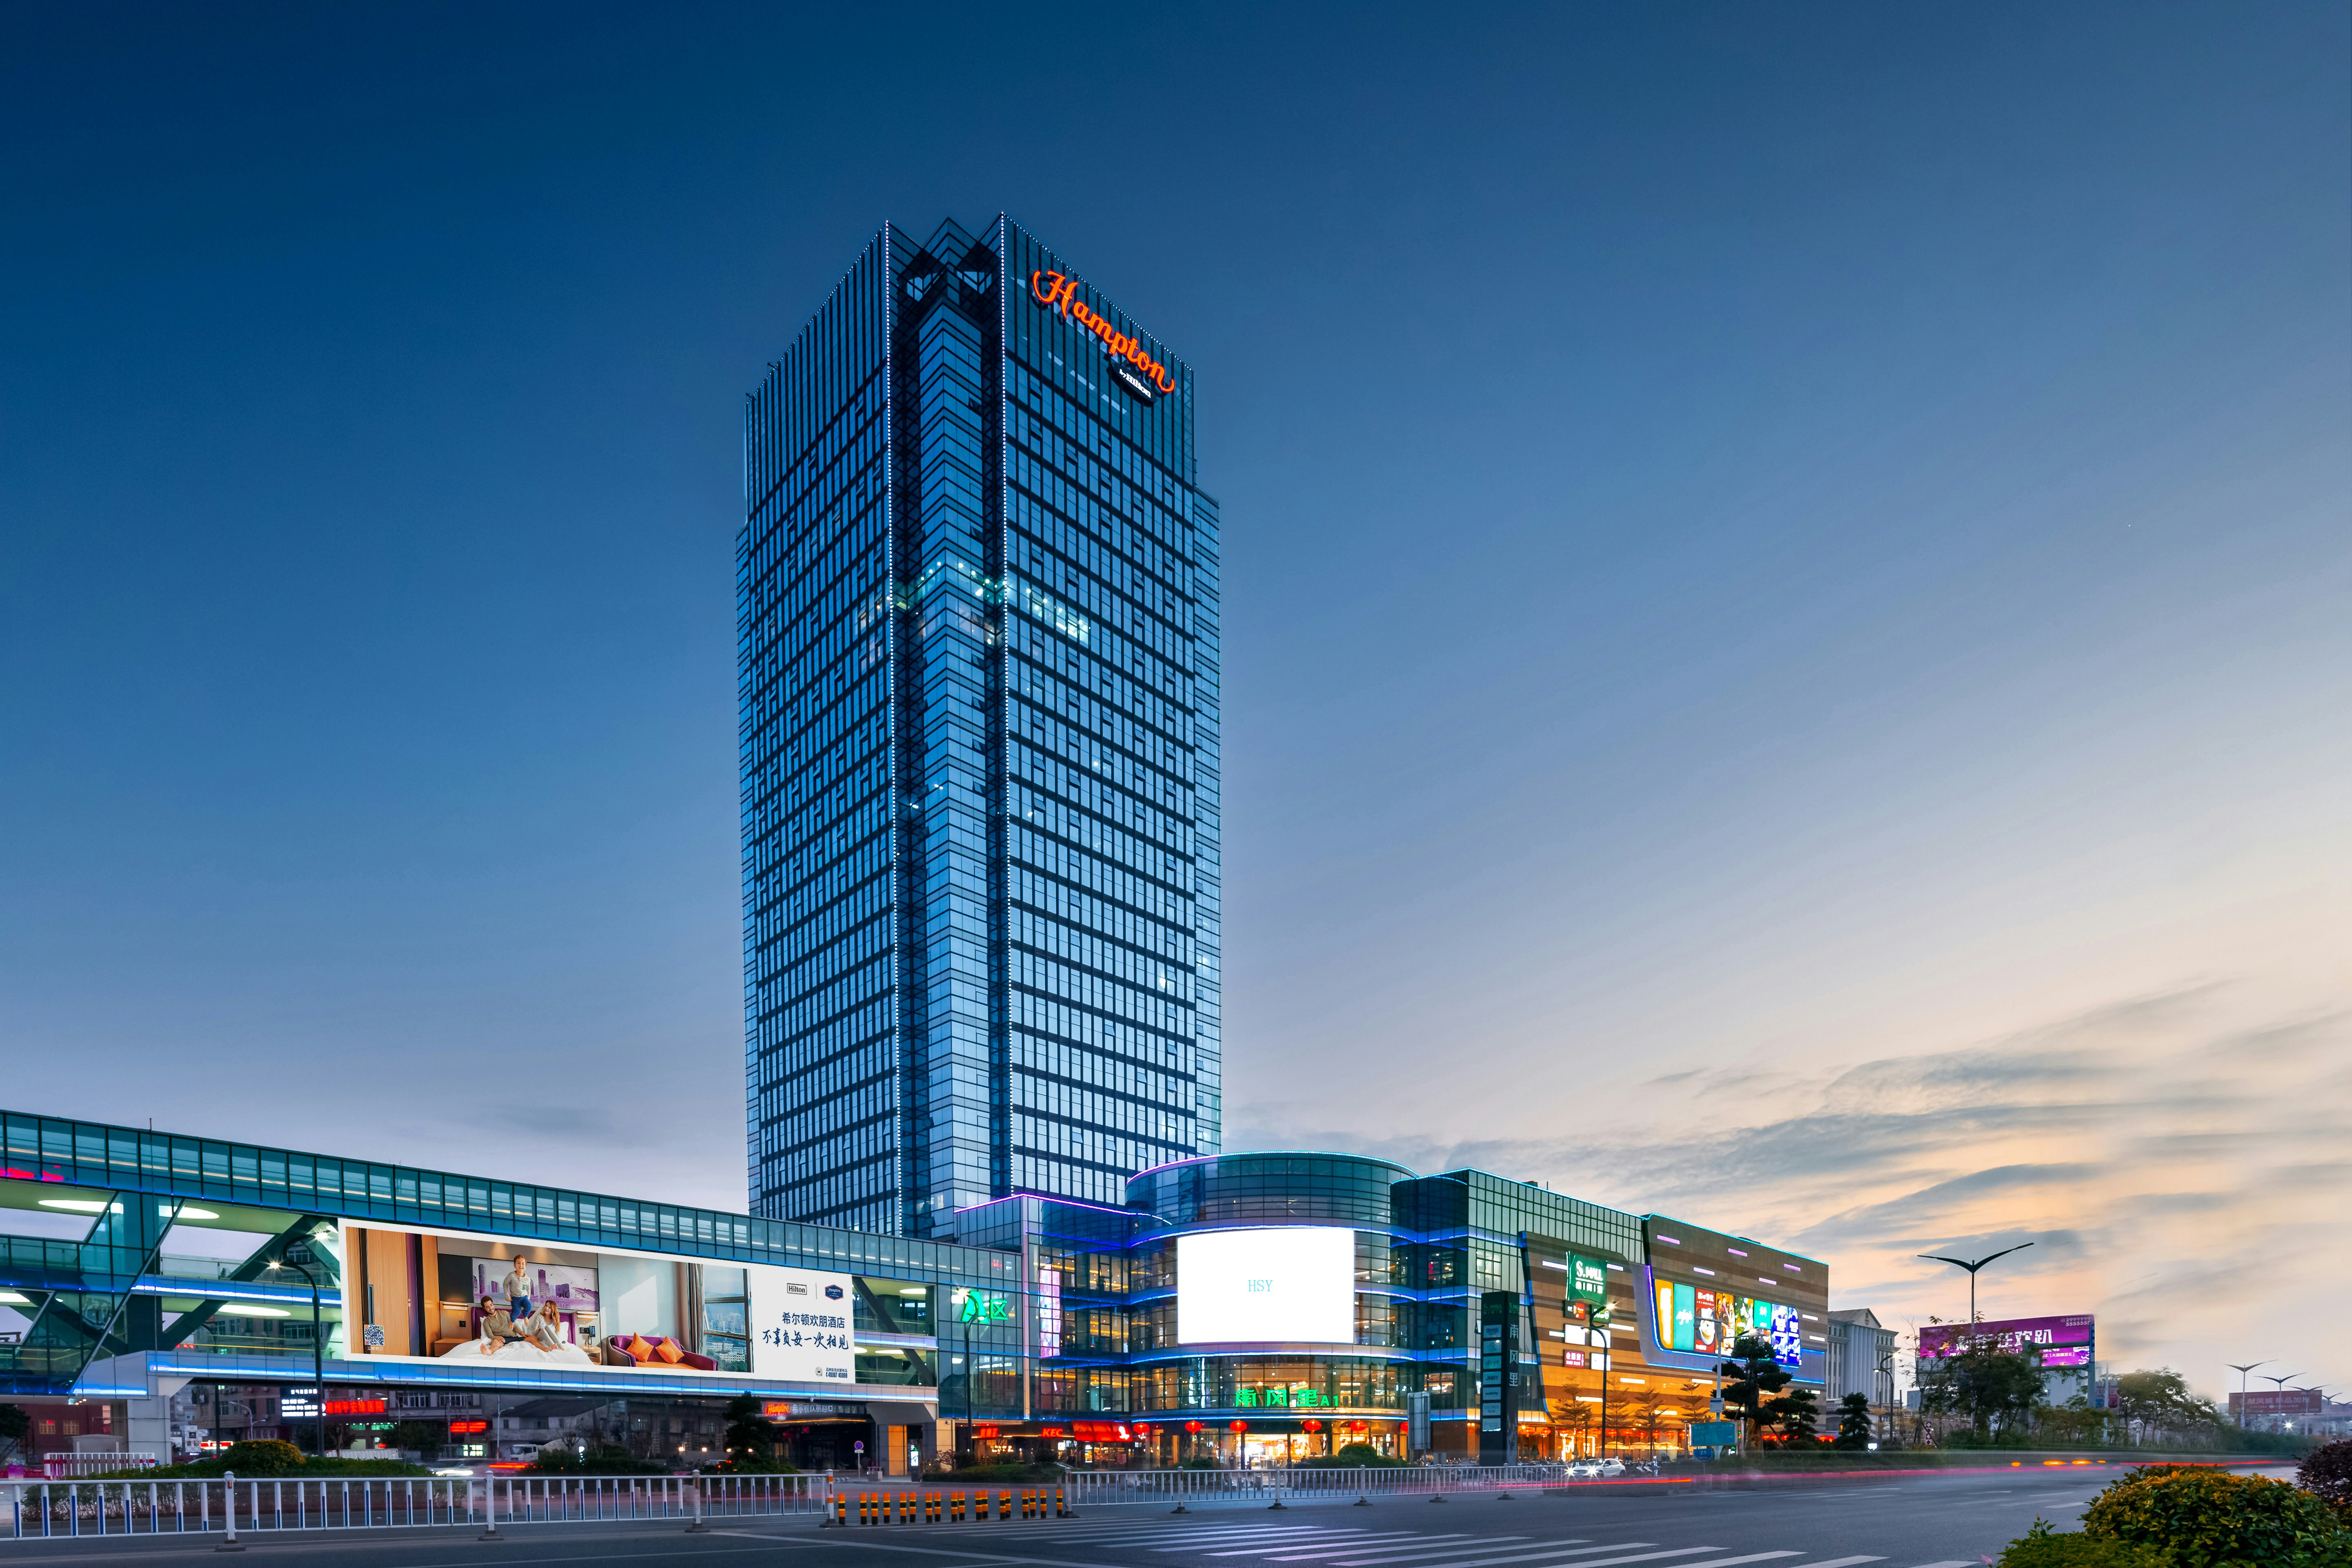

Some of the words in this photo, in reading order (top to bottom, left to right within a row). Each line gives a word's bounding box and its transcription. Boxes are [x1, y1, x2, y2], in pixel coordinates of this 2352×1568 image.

[1033, 270, 1175, 392] Hampton
[1576, 1261, 1603, 1281] S.MALL
[1248, 1279, 1273, 1292] HSY
[962, 1290, 1008, 1324] A区
[782, 1312, 845, 1328] 希尔顿欢朋酒店
[762, 1327, 849, 1350] 不辜负每一次相见
[1509, 1324, 1519, 1386] 南风里
[765, 1404, 791, 1416] Hampton
